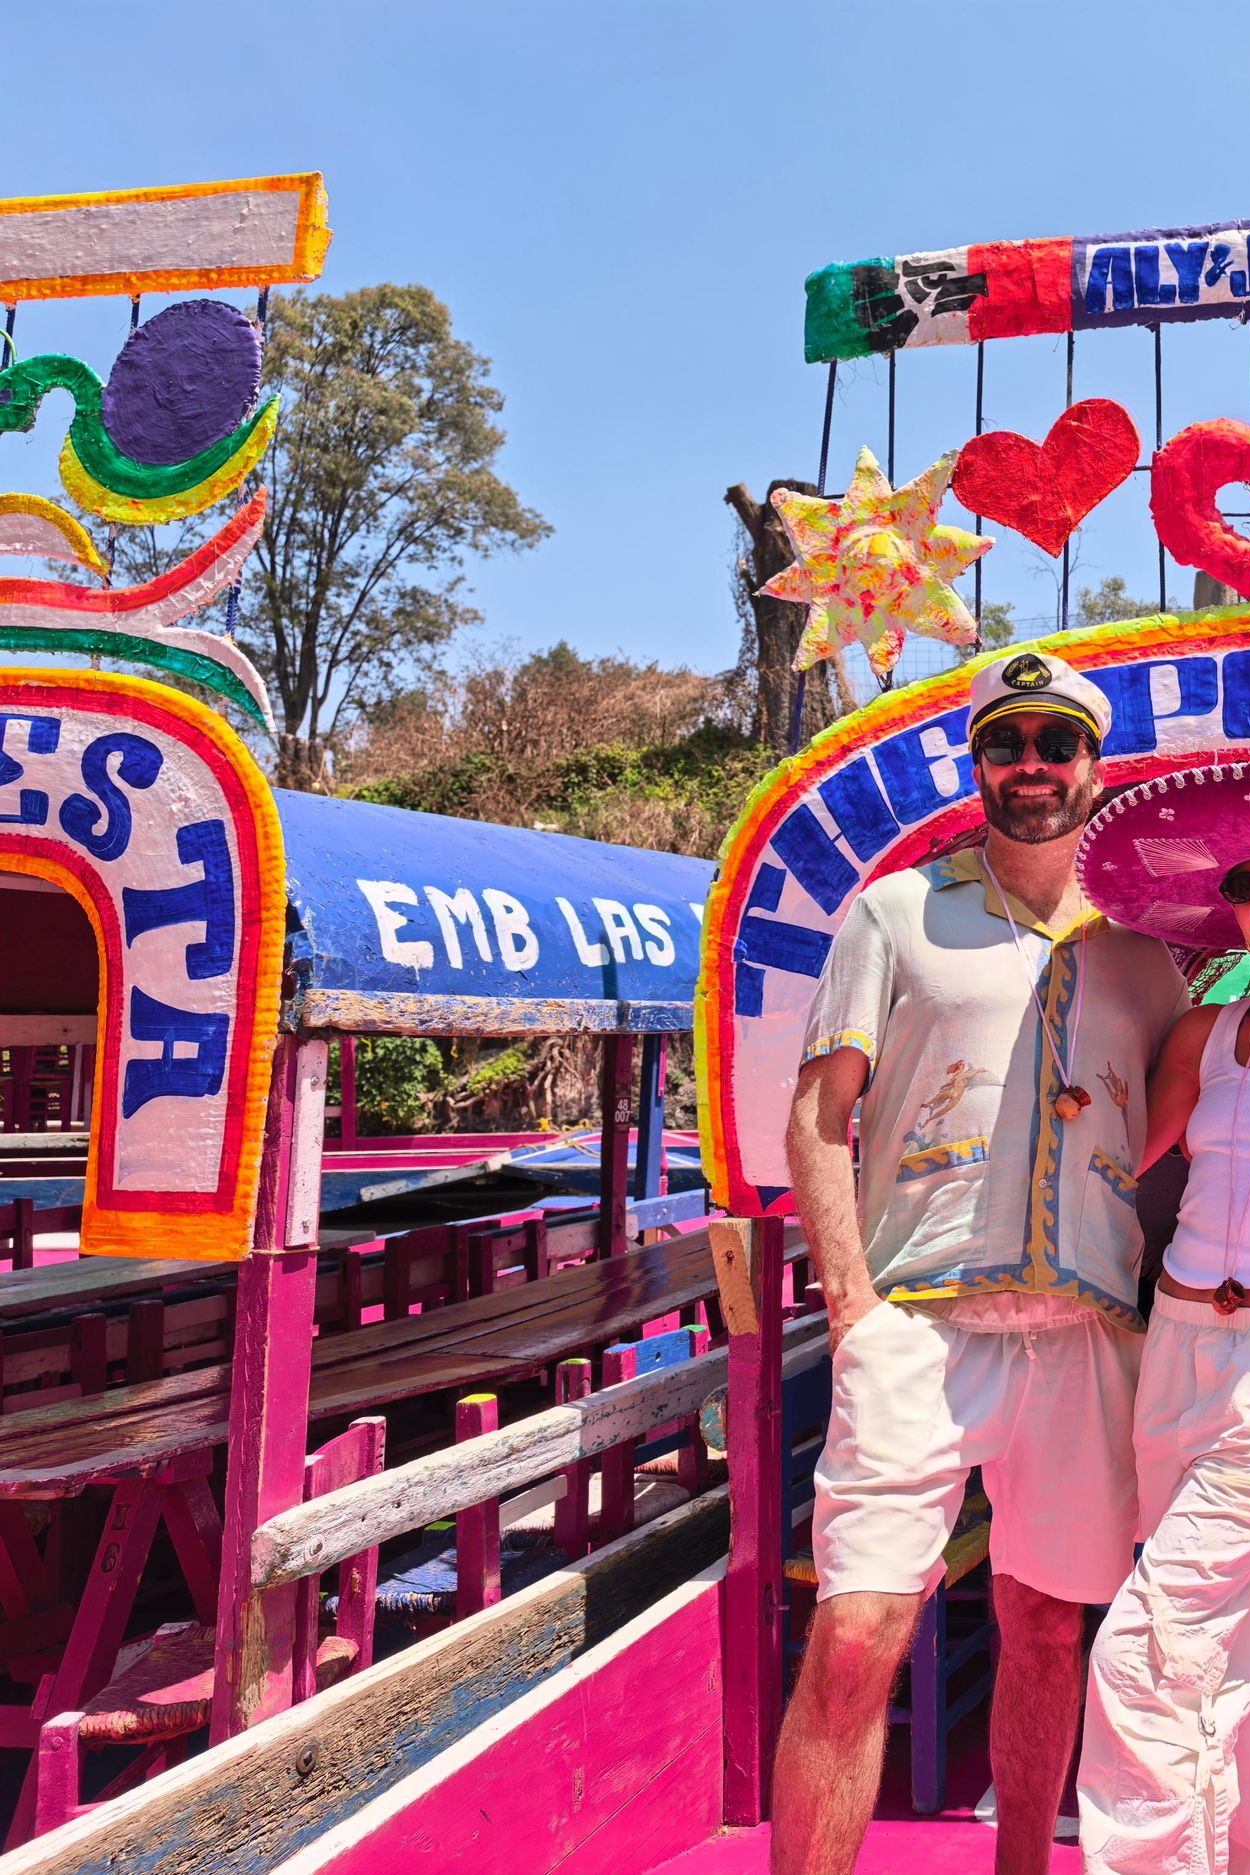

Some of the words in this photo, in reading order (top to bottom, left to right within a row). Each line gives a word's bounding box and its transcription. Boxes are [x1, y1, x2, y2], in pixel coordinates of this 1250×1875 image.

[1011, 679, 1044, 688] CAPTAIN
[733, 705, 980, 1018] THE
[0, 713, 236, 1120] ESTA
[356, 878, 540, 972] EMB
[555, 896, 676, 968] LAS
[614, 1110, 631, 1123] 007
[617, 1098, 629, 1110] 48
